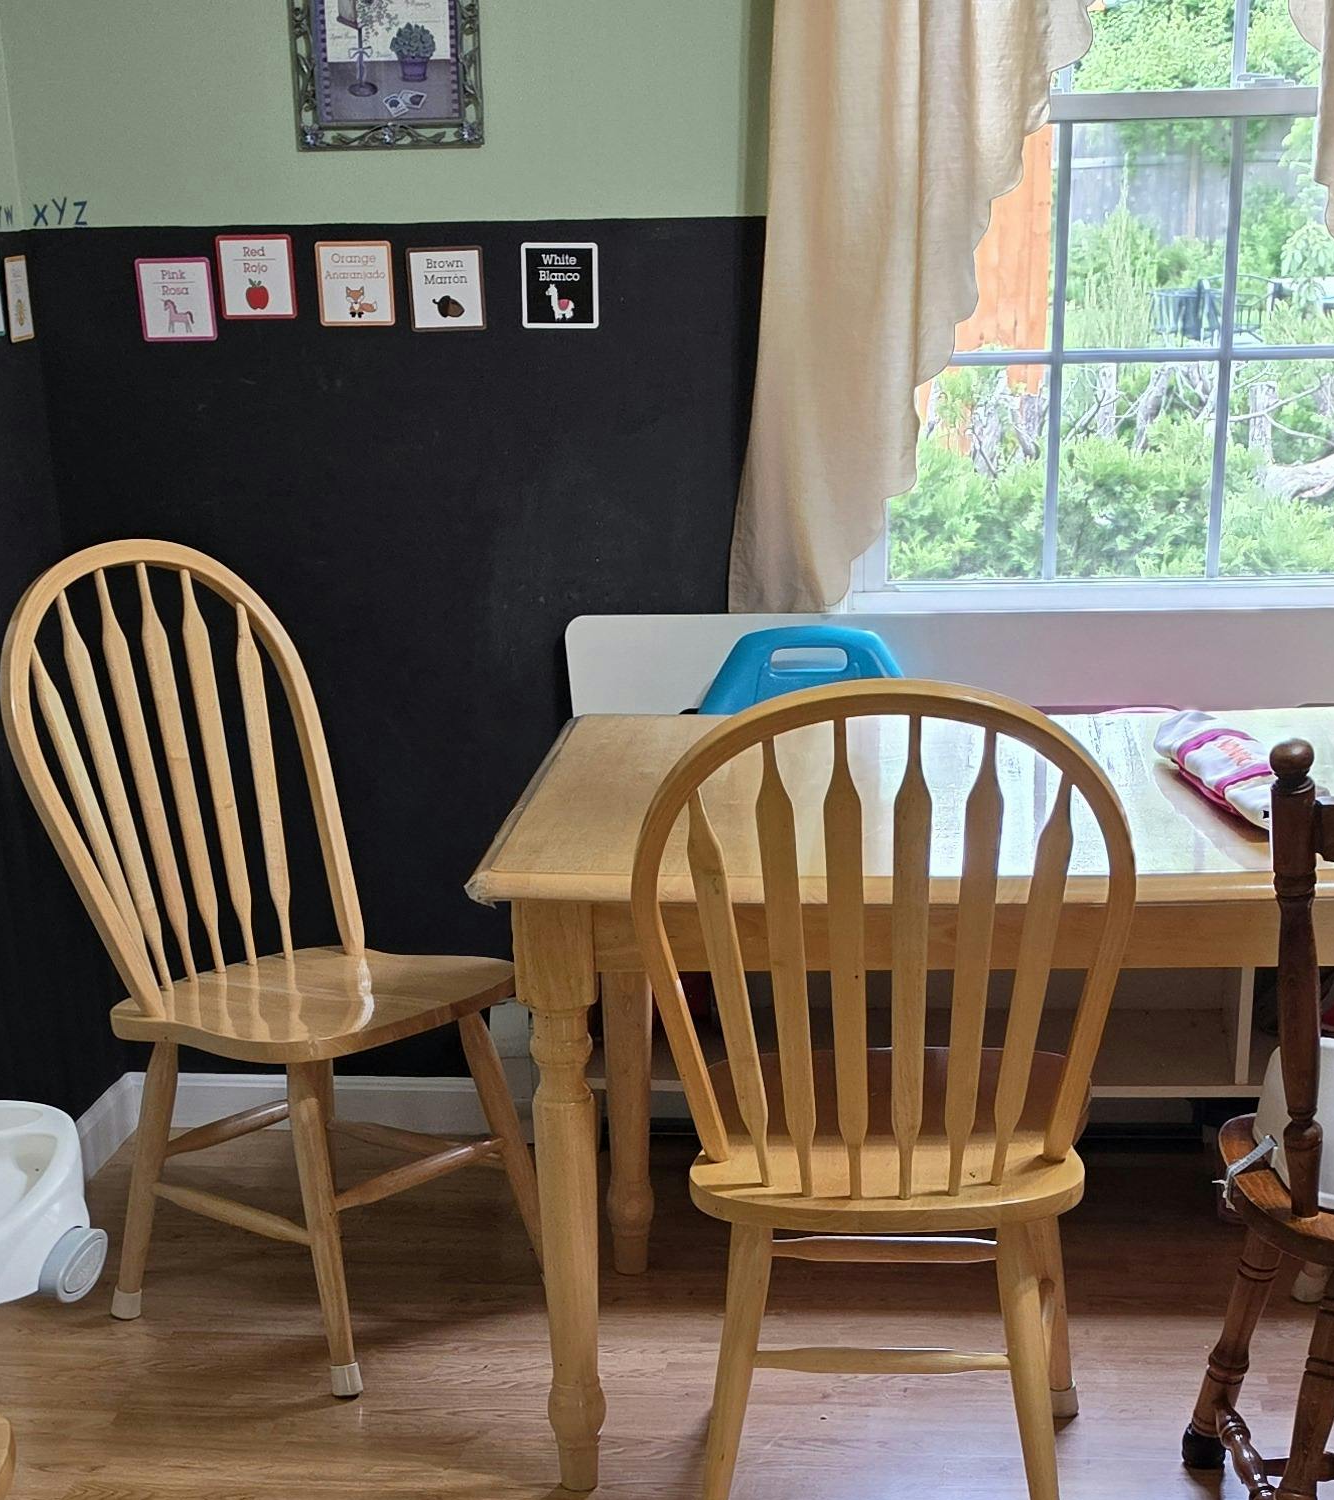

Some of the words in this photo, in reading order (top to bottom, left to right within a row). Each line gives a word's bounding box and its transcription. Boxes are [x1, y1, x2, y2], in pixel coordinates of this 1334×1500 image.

[243, 246, 266, 257] Red
[331, 253, 376, 266] Orange
[426, 258, 464, 269] Brown
[541, 253, 577, 266] White
[243, 262, 267, 273] Rojo
[160, 269, 186, 280] Pink
[325, 269, 386, 281] Anaranjado
[539, 270, 580, 282] Blanco
[162, 286, 189, 296] Rosa
